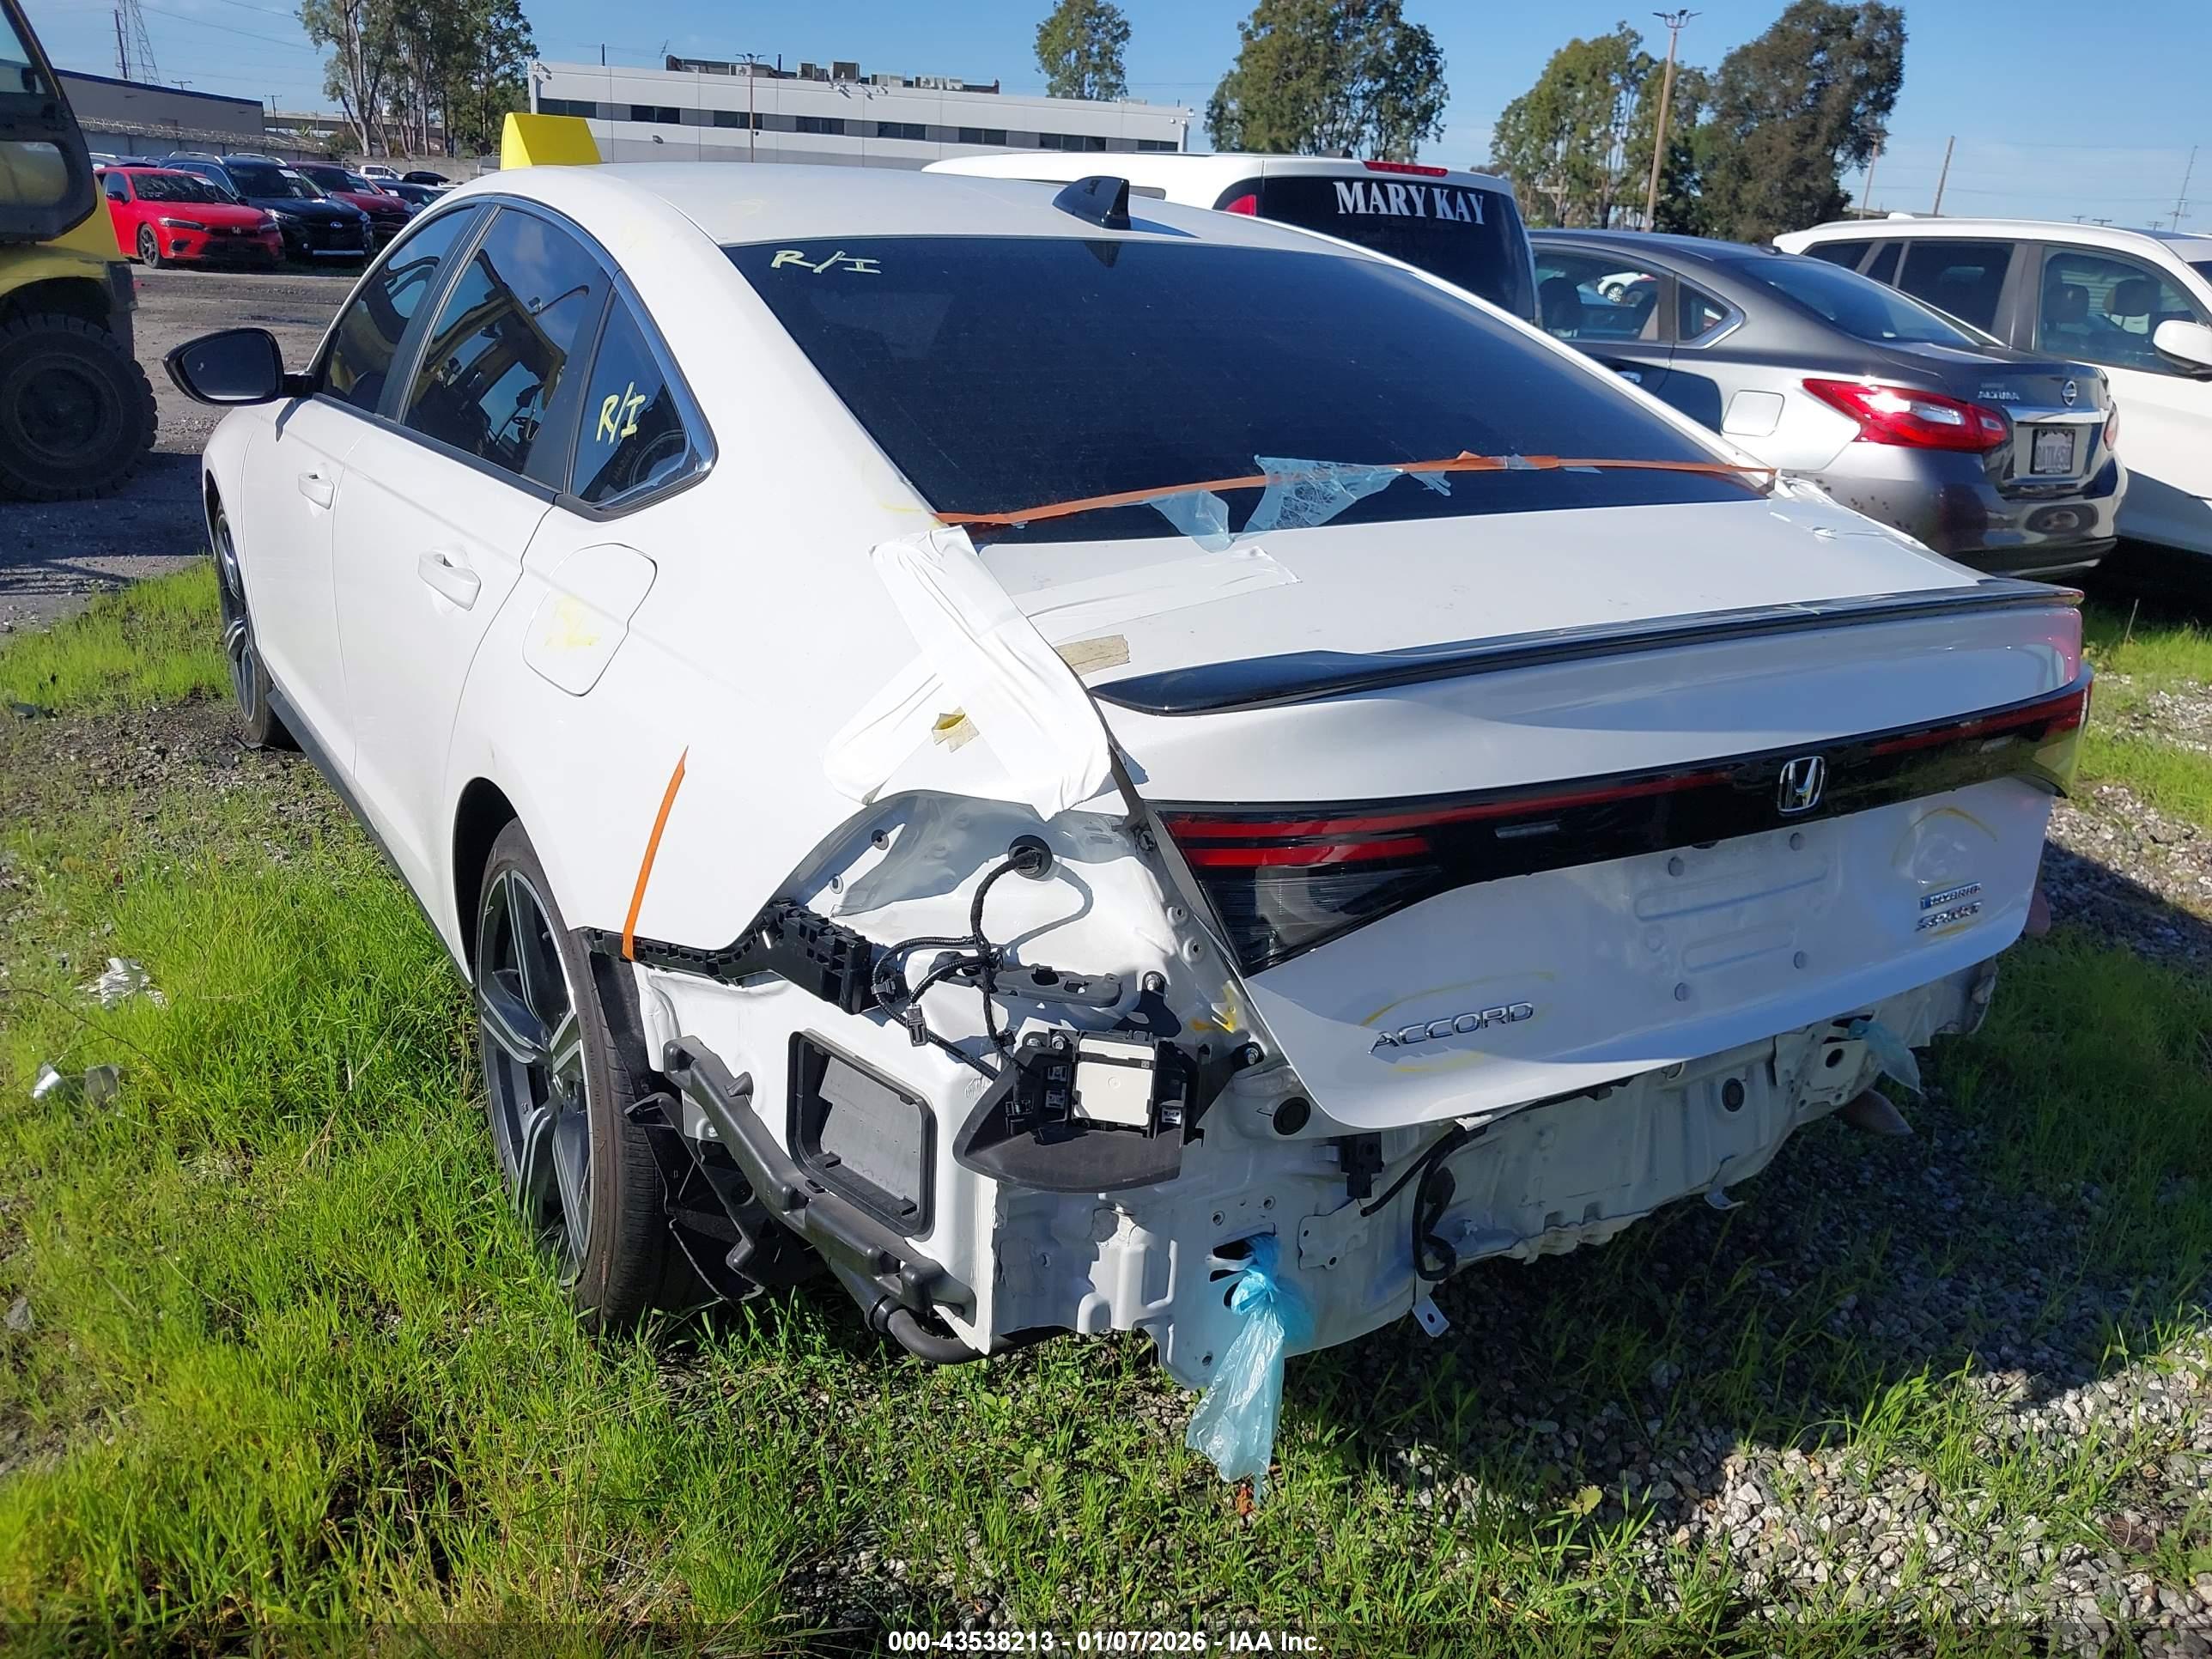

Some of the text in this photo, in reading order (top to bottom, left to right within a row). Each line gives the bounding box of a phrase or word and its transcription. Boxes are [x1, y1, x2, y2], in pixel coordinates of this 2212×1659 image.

[1333, 180, 1486, 226] MARY KAY
[596, 381, 646, 446] R/I
[1367, 1000, 1534, 1055] ACCORD
